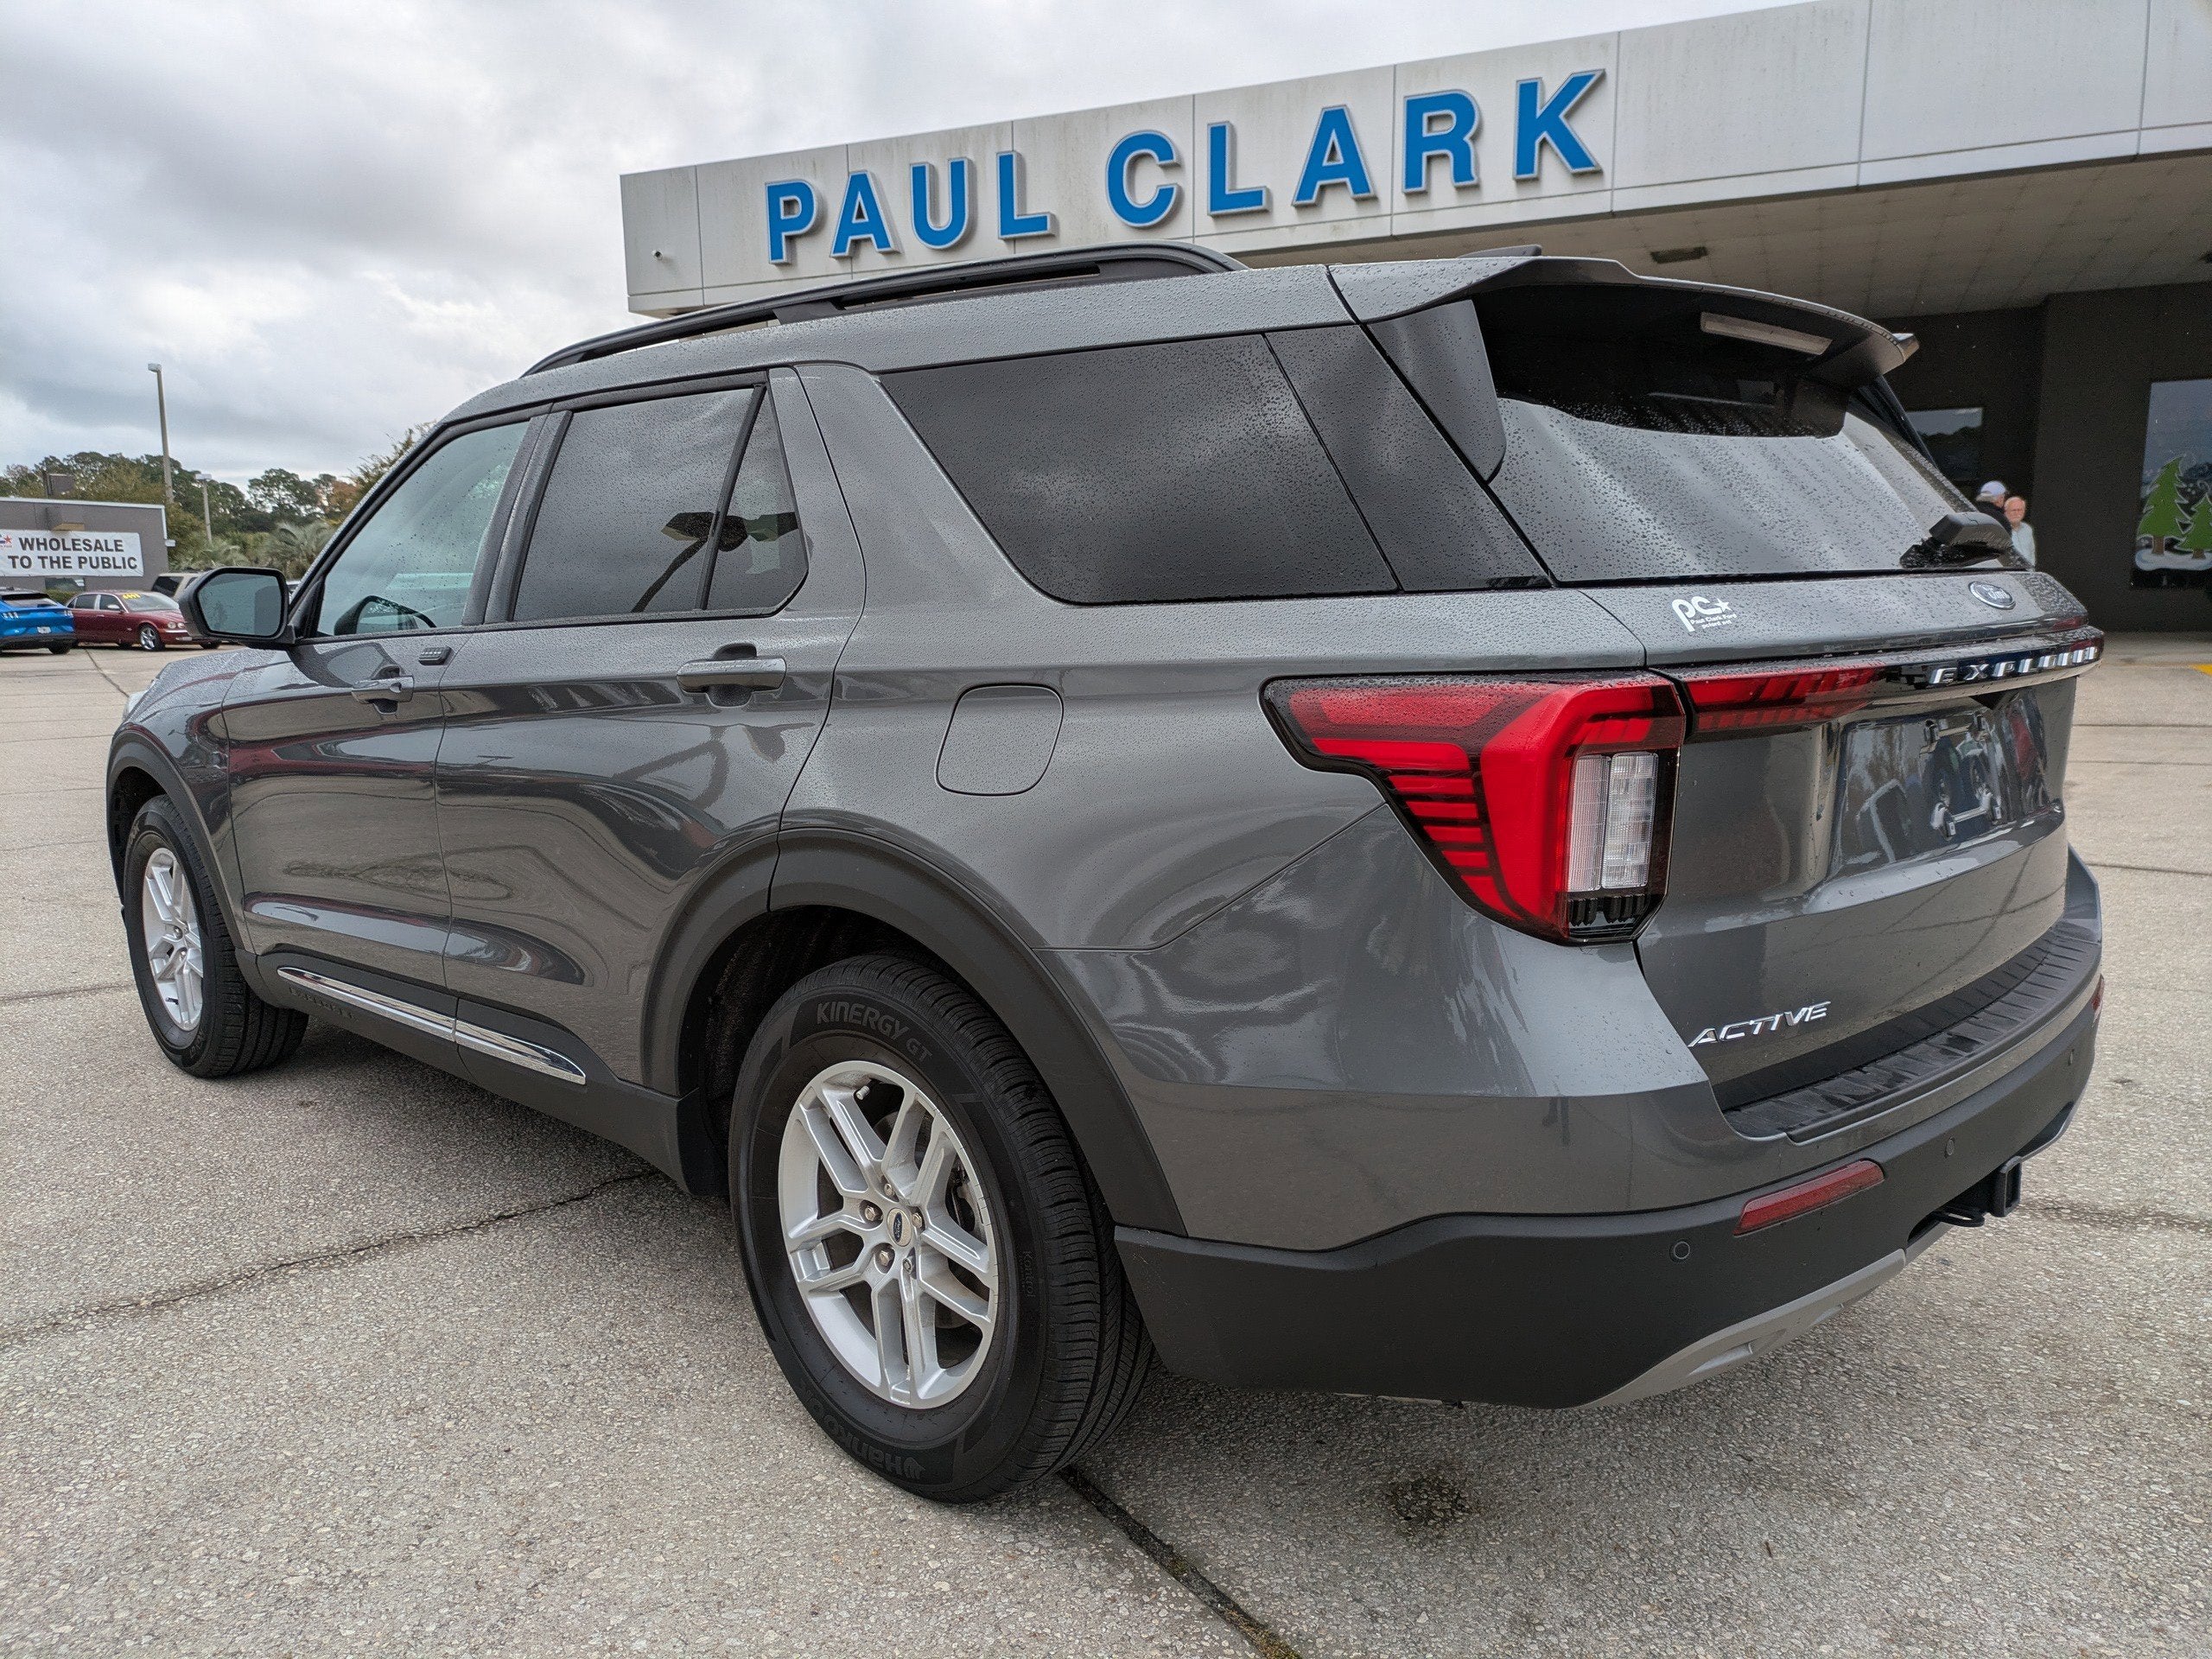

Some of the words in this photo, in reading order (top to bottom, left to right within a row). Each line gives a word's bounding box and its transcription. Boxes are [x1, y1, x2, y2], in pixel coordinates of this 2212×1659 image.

[765, 150, 1054, 264] PAUL
[1105, 68, 1605, 228] CLARK
[8, 556, 32, 569] TO
[37, 556, 73, 569] THE
[78, 556, 137, 569] PUBLIC
[18, 537, 124, 552] WHOLESALE
[816, 1000, 910, 1040] KINERGY
[905, 1037, 933, 1063] GT
[1688, 1001, 1831, 1047] ACTIVE
